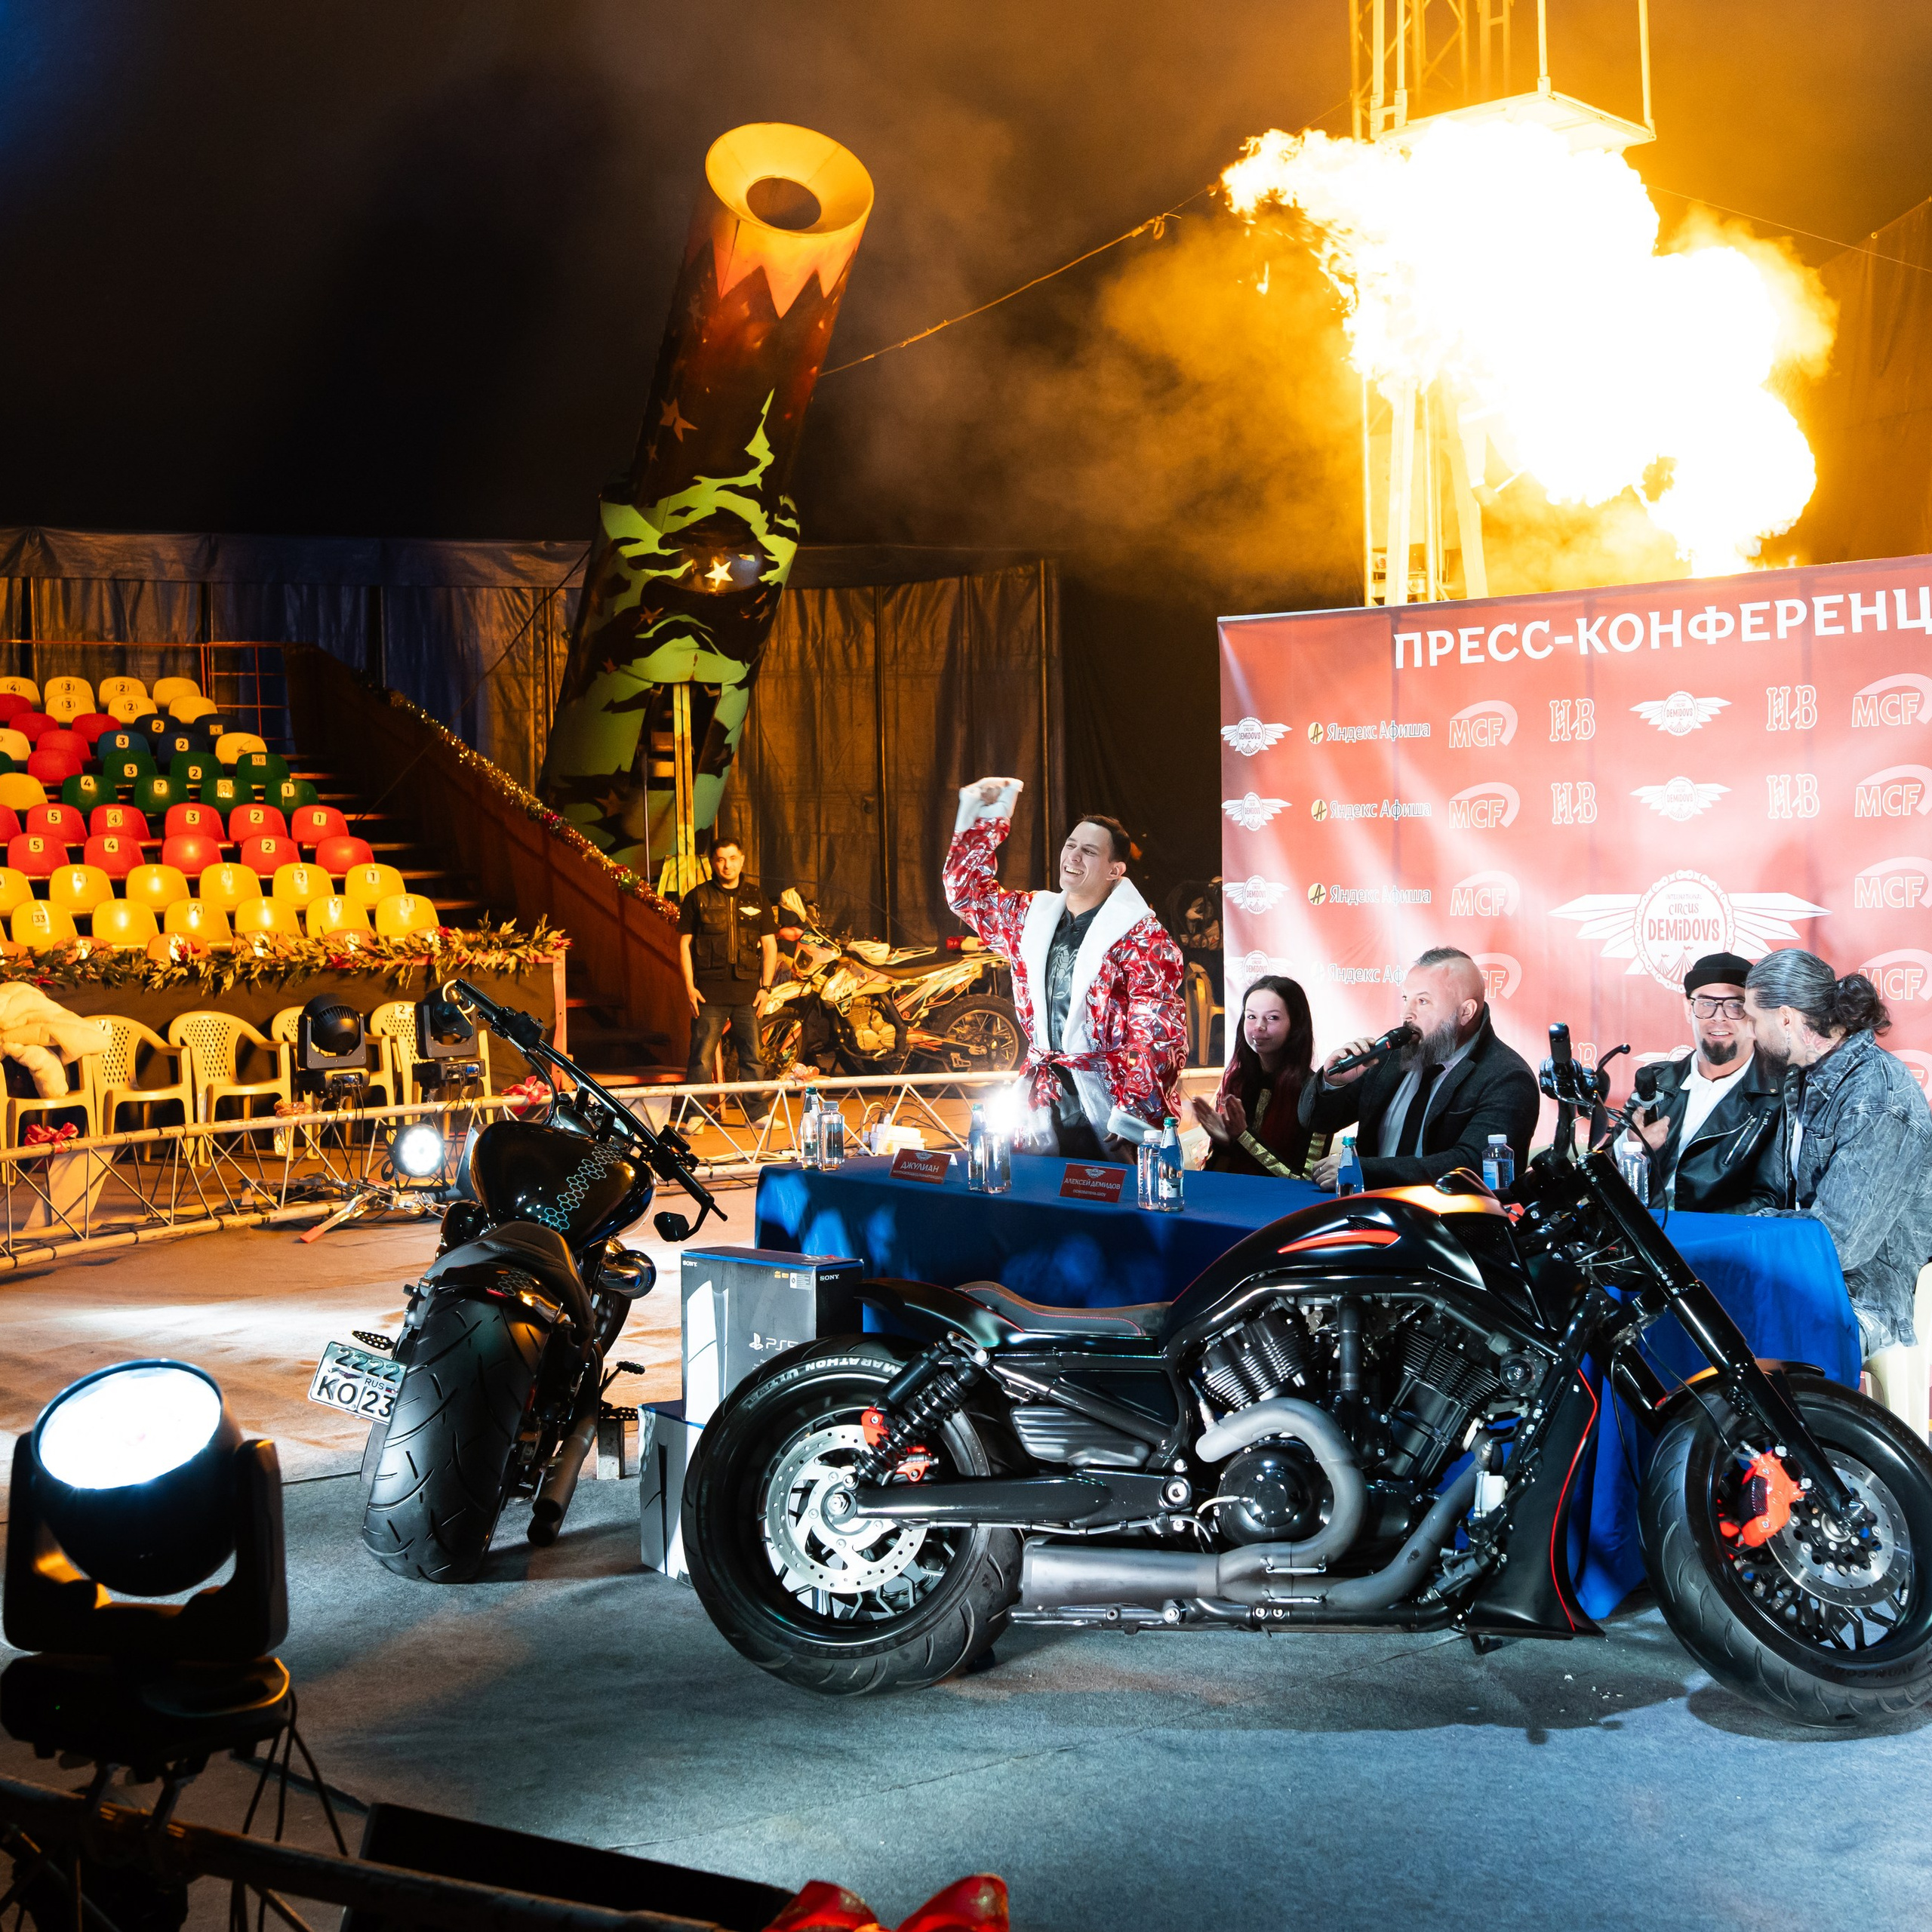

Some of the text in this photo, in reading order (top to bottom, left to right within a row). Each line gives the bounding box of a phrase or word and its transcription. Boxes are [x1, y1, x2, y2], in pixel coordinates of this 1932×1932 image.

[10, 684, 17, 692] 4
[65, 683, 72, 691] 3
[119, 684, 126, 692] 2
[66, 700, 72, 709] 3
[128, 703, 134, 711] 2
[1851, 693, 1921, 728] MCF
[155, 722, 162, 731] 2
[1326, 720, 1430, 743] Яндекс Афиша
[1448, 718, 1503, 749] MCF
[119, 737, 125, 746] 3
[179, 740, 186, 749] 2
[127, 766, 134, 775] 3
[192, 768, 198, 777] 2
[84, 778, 91, 787] 4
[285, 786, 290, 794] 1
[1854, 783, 1922, 817] MCF
[1329, 798, 1432, 820] Яндекс Афиша
[51, 812, 58, 821] 5
[189, 813, 196, 822] 3
[254, 812, 260, 821] 2
[315, 814, 321, 823] 1
[1449, 799, 1505, 829] MCF
[32, 841, 40, 850] 5
[107, 841, 115, 850] 4
[265, 841, 272, 851] 2
[370, 872, 375, 881] 1
[1328, 881, 1432, 905] Яндекс Афиша
[1854, 875, 1925, 909] MCF
[1449, 888, 1506, 916] MCF
[1669, 903, 1700, 915] CIRCUS
[1327, 963, 1380, 984] Яндекс
[398, 1004, 405, 1014] 2
[900, 1161, 940, 1173] ДЖУЛИАН
[1063, 1177, 1121, 1190] АЛЕКСЕЙ ДЕМИДОВ
[819, 1273, 840, 1281] SONY
[335, 1347, 400, 1383] 2222
[805, 1357, 903, 1375] MARATHON
[364, 1377, 385, 1390] RUS
[361, 1390, 395, 1417] 23
